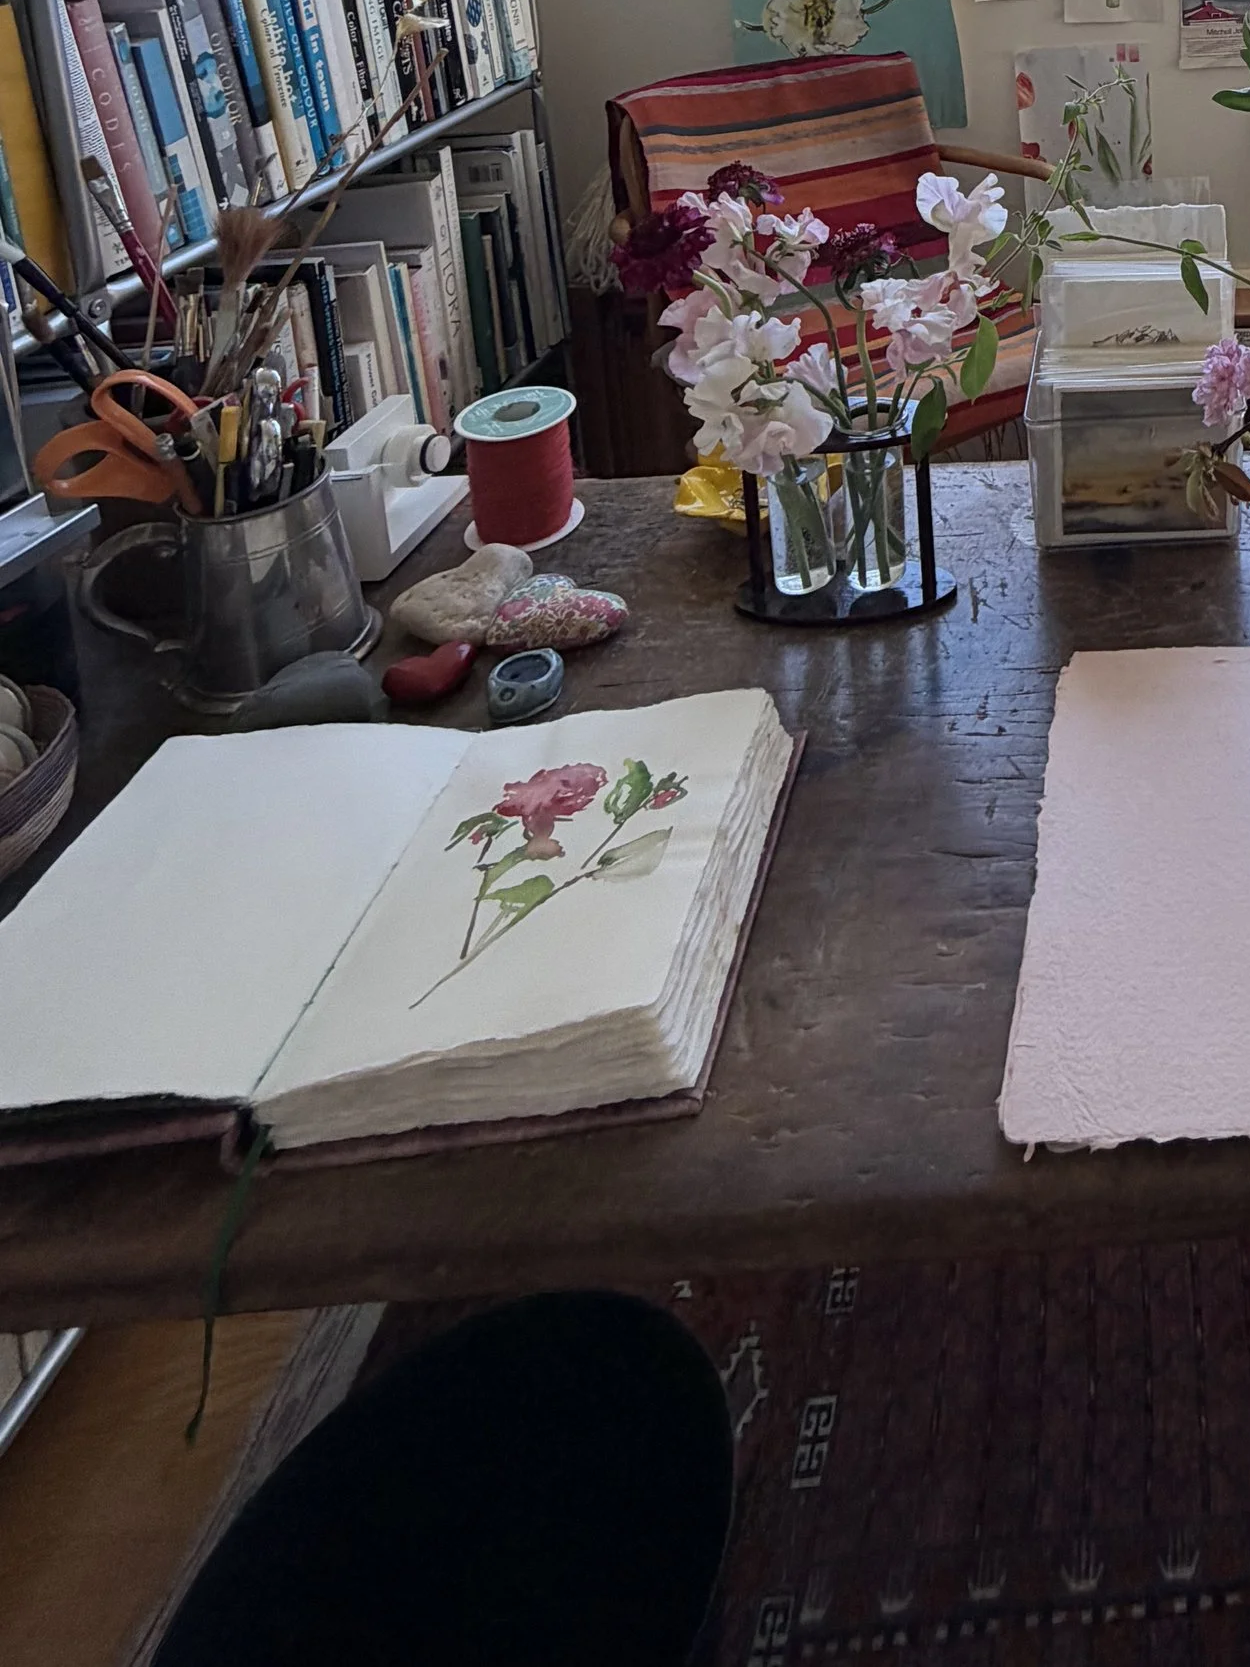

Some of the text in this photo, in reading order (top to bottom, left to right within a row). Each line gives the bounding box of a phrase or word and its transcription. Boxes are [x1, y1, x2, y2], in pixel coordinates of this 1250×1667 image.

[290, 34, 303, 60] ON
[309, 33, 320, 51] in
[315, 58, 332, 112] town
[345, 10, 359, 43] Color
[355, 60, 368, 91] Fiber
[217, 62, 243, 126] COLOR
[270, 63, 288, 109] Provence
[296, 64, 319, 129] COLOUR
[439, 247, 463, 338] FLORA
